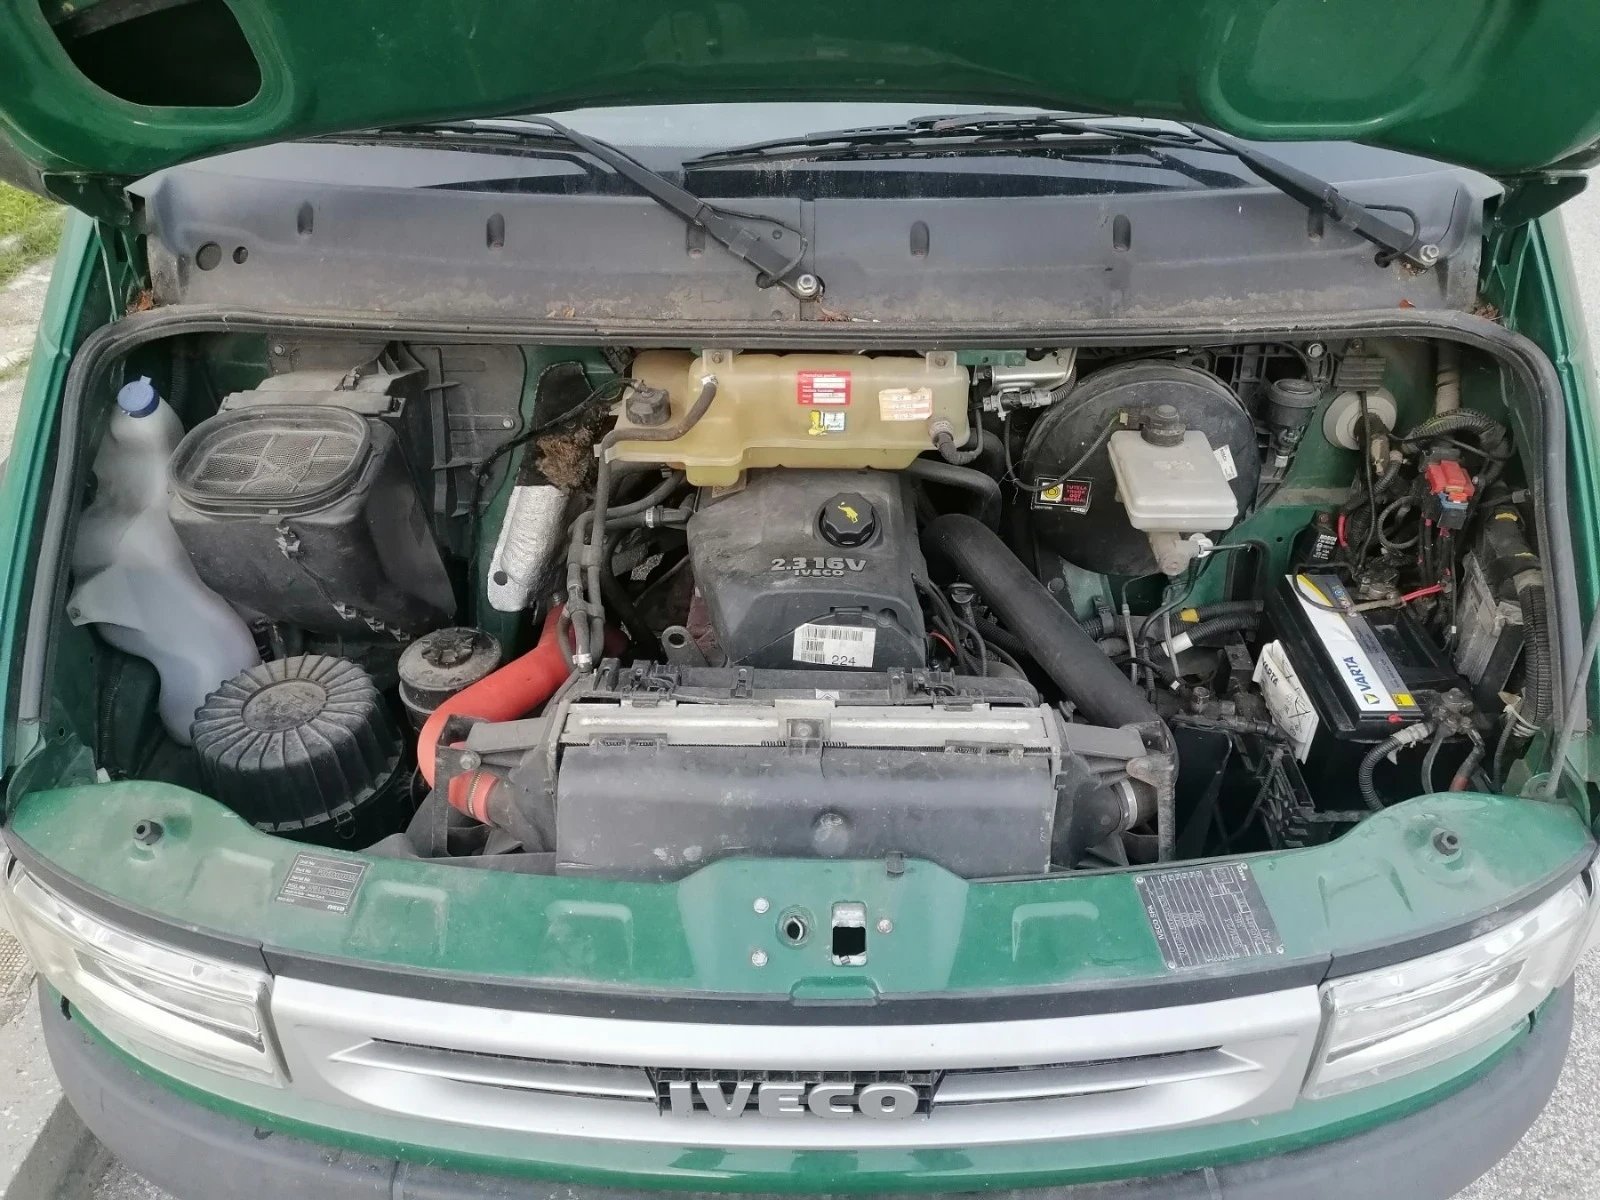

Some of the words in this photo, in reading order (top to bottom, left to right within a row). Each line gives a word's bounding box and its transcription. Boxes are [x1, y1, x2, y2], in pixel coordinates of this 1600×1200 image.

[771, 557, 807, 571] 2.3
[813, 556, 867, 572] 16V
[794, 569, 845, 577] IVECO
[831, 655, 856, 666] 224
[1341, 656, 1374, 692] VARTA
[1146, 904, 1156, 918] SPA
[1152, 919, 1164, 939] IVECO
[669, 1081, 919, 1119] IVECO
